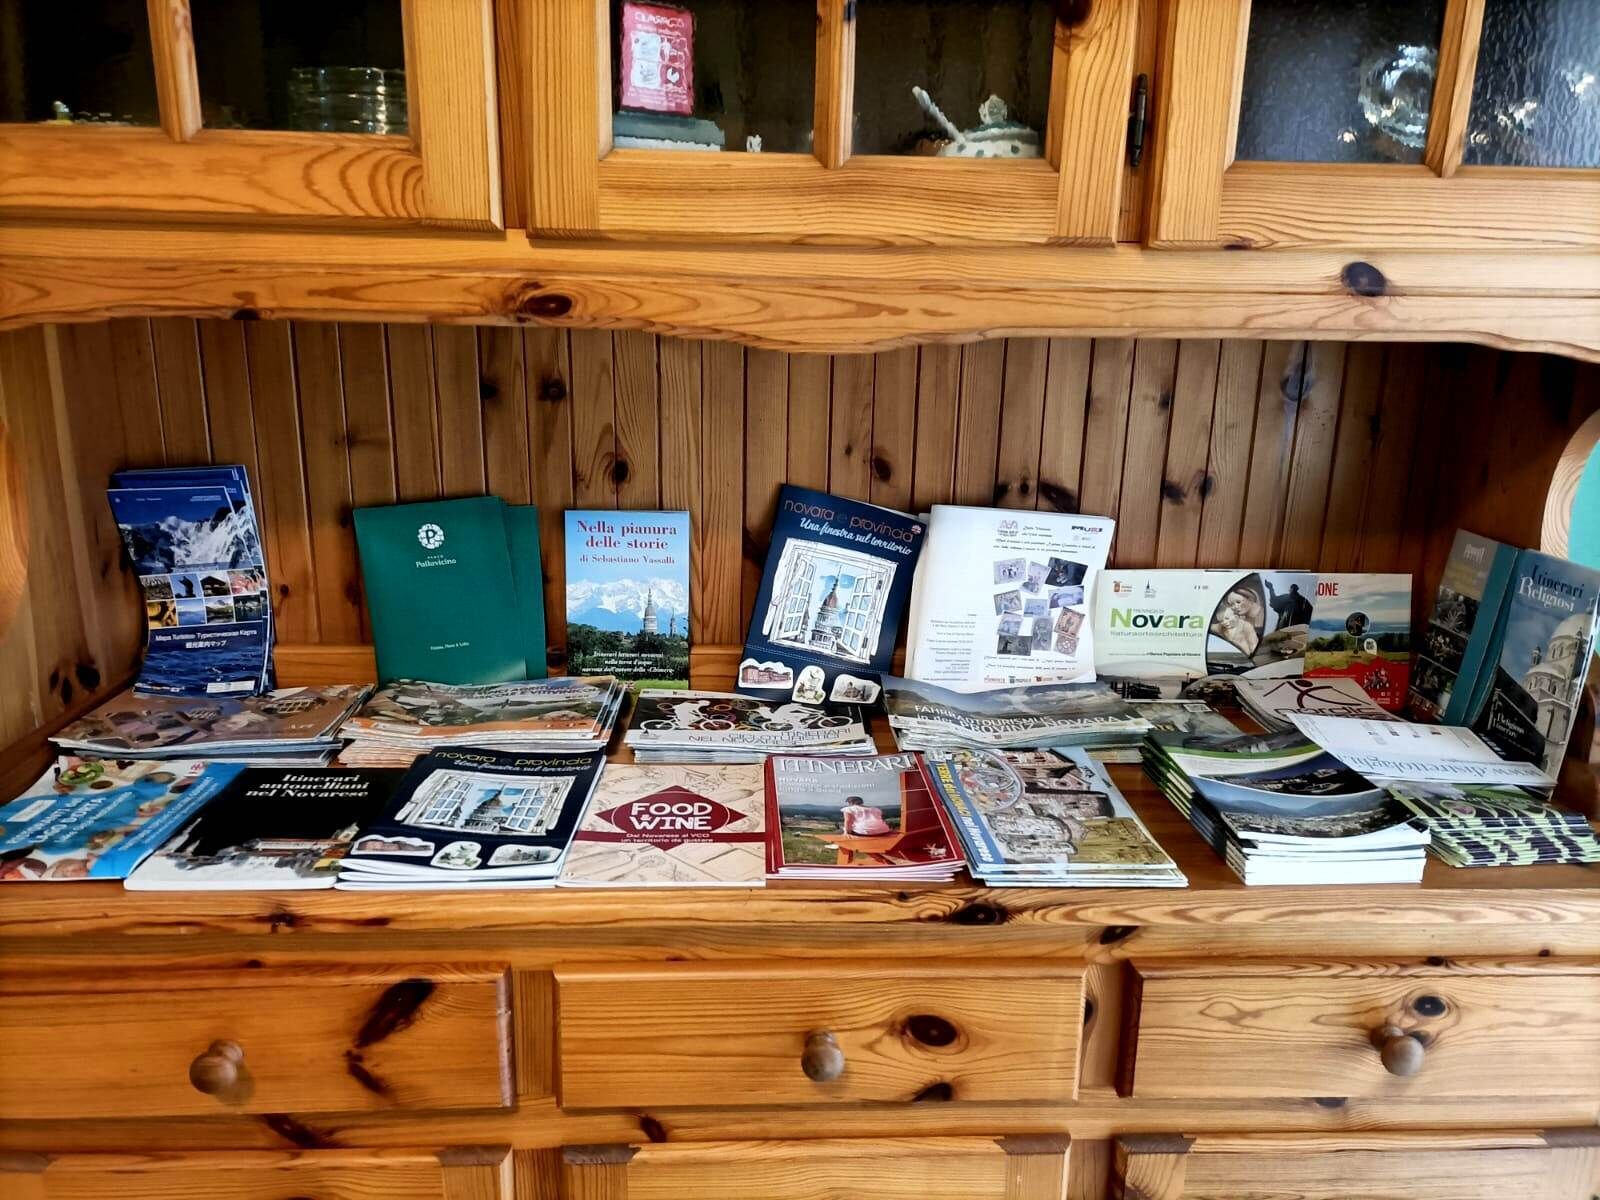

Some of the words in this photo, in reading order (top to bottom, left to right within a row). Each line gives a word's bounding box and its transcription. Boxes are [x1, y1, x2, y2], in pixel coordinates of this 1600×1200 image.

[577, 520, 615, 534] Nella
[621, 522, 677, 537] pianura
[784, 499, 835, 521] novara
[848, 515, 915, 544] provincia
[585, 536, 621, 548] delle
[626, 538, 669, 549] storie
[799, 517, 821, 532] Una
[820, 521, 856, 541] finestra
[855, 533, 872, 544] sul
[870, 537, 913, 556] territorio
[580, 554, 589, 562] di
[592, 554, 640, 563] Sebastiano
[643, 556, 675, 564] Vassalli
[1530, 563, 1585, 598] Itinerari
[1518, 574, 1575, 612] Religiosi
[1109, 607, 1204, 629] Novara
[1042, 715, 1119, 730] NOVARA
[781, 728, 851, 738] ITINERARI
[721, 736, 801, 745] NOVARESE
[434, 751, 497, 764] novara
[514, 757, 593, 767] provincia
[778, 752, 913, 775] ITINERARI
[453, 760, 479, 768] Una
[478, 761, 521, 771] finestra
[522, 764, 541, 772] sul
[541, 765, 592, 773] territorio
[282, 774, 361, 782] Itinerari
[259, 782, 370, 790] antonelliani
[245, 789, 278, 797] nel
[279, 789, 369, 798] Novarese
[630, 802, 713, 816] FOOD
[629, 816, 713, 831] WINE
[640, 813, 652, 822] &
